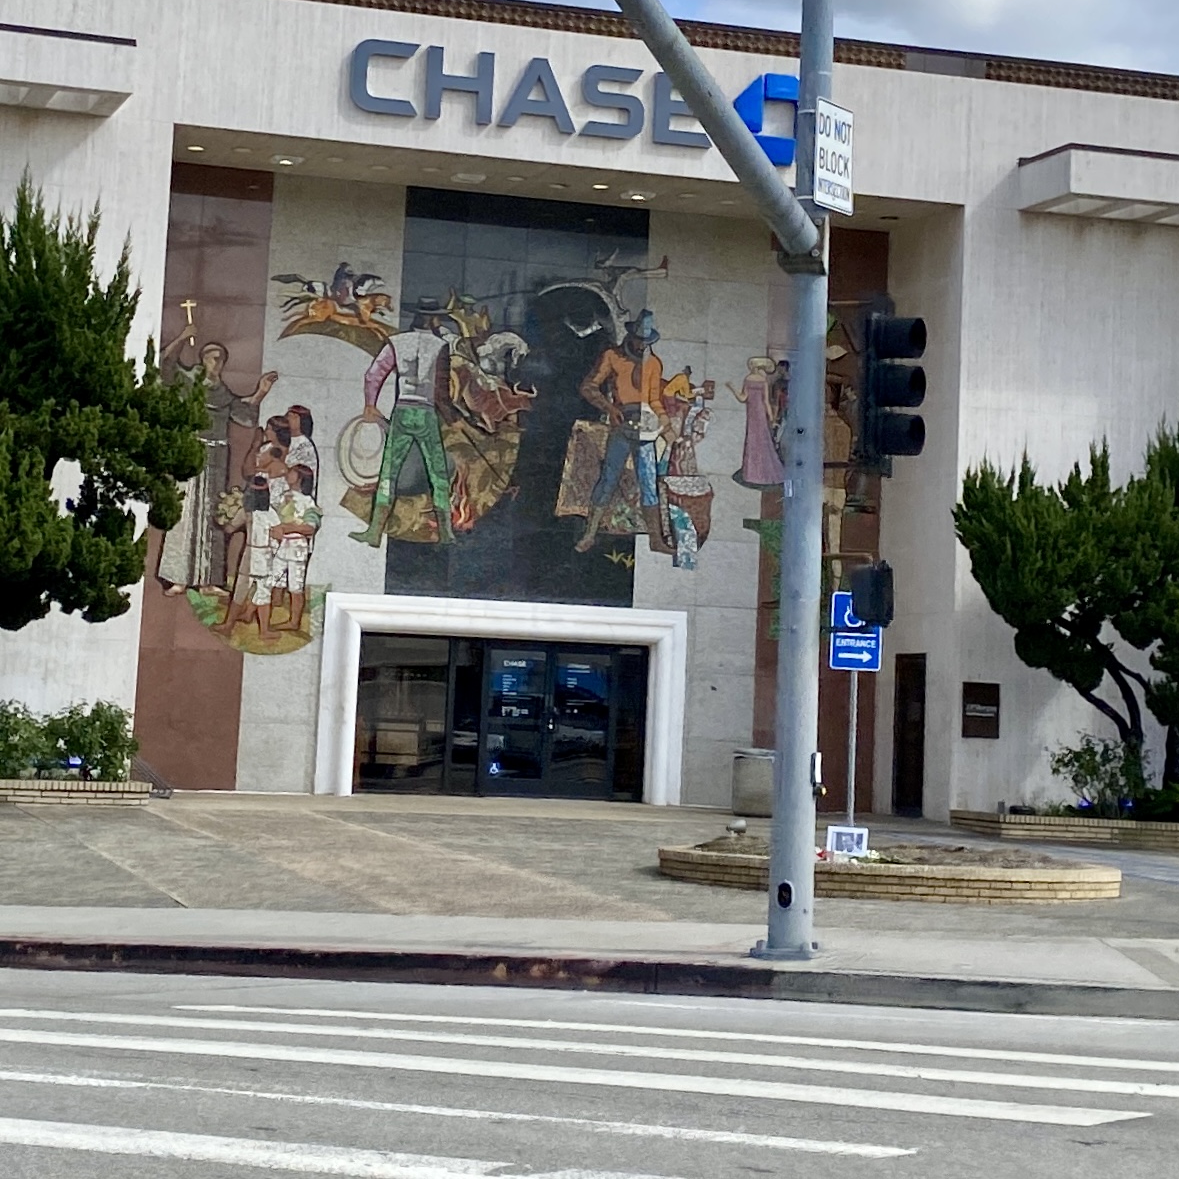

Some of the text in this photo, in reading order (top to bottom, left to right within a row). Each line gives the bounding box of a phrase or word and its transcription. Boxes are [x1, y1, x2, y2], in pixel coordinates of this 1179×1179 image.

[349, 37, 712, 151] CHASE
[819, 112, 852, 146] DO NOT
[819, 146, 850, 179] BLOCK
[835, 638, 876, 648] ENTRANCE
